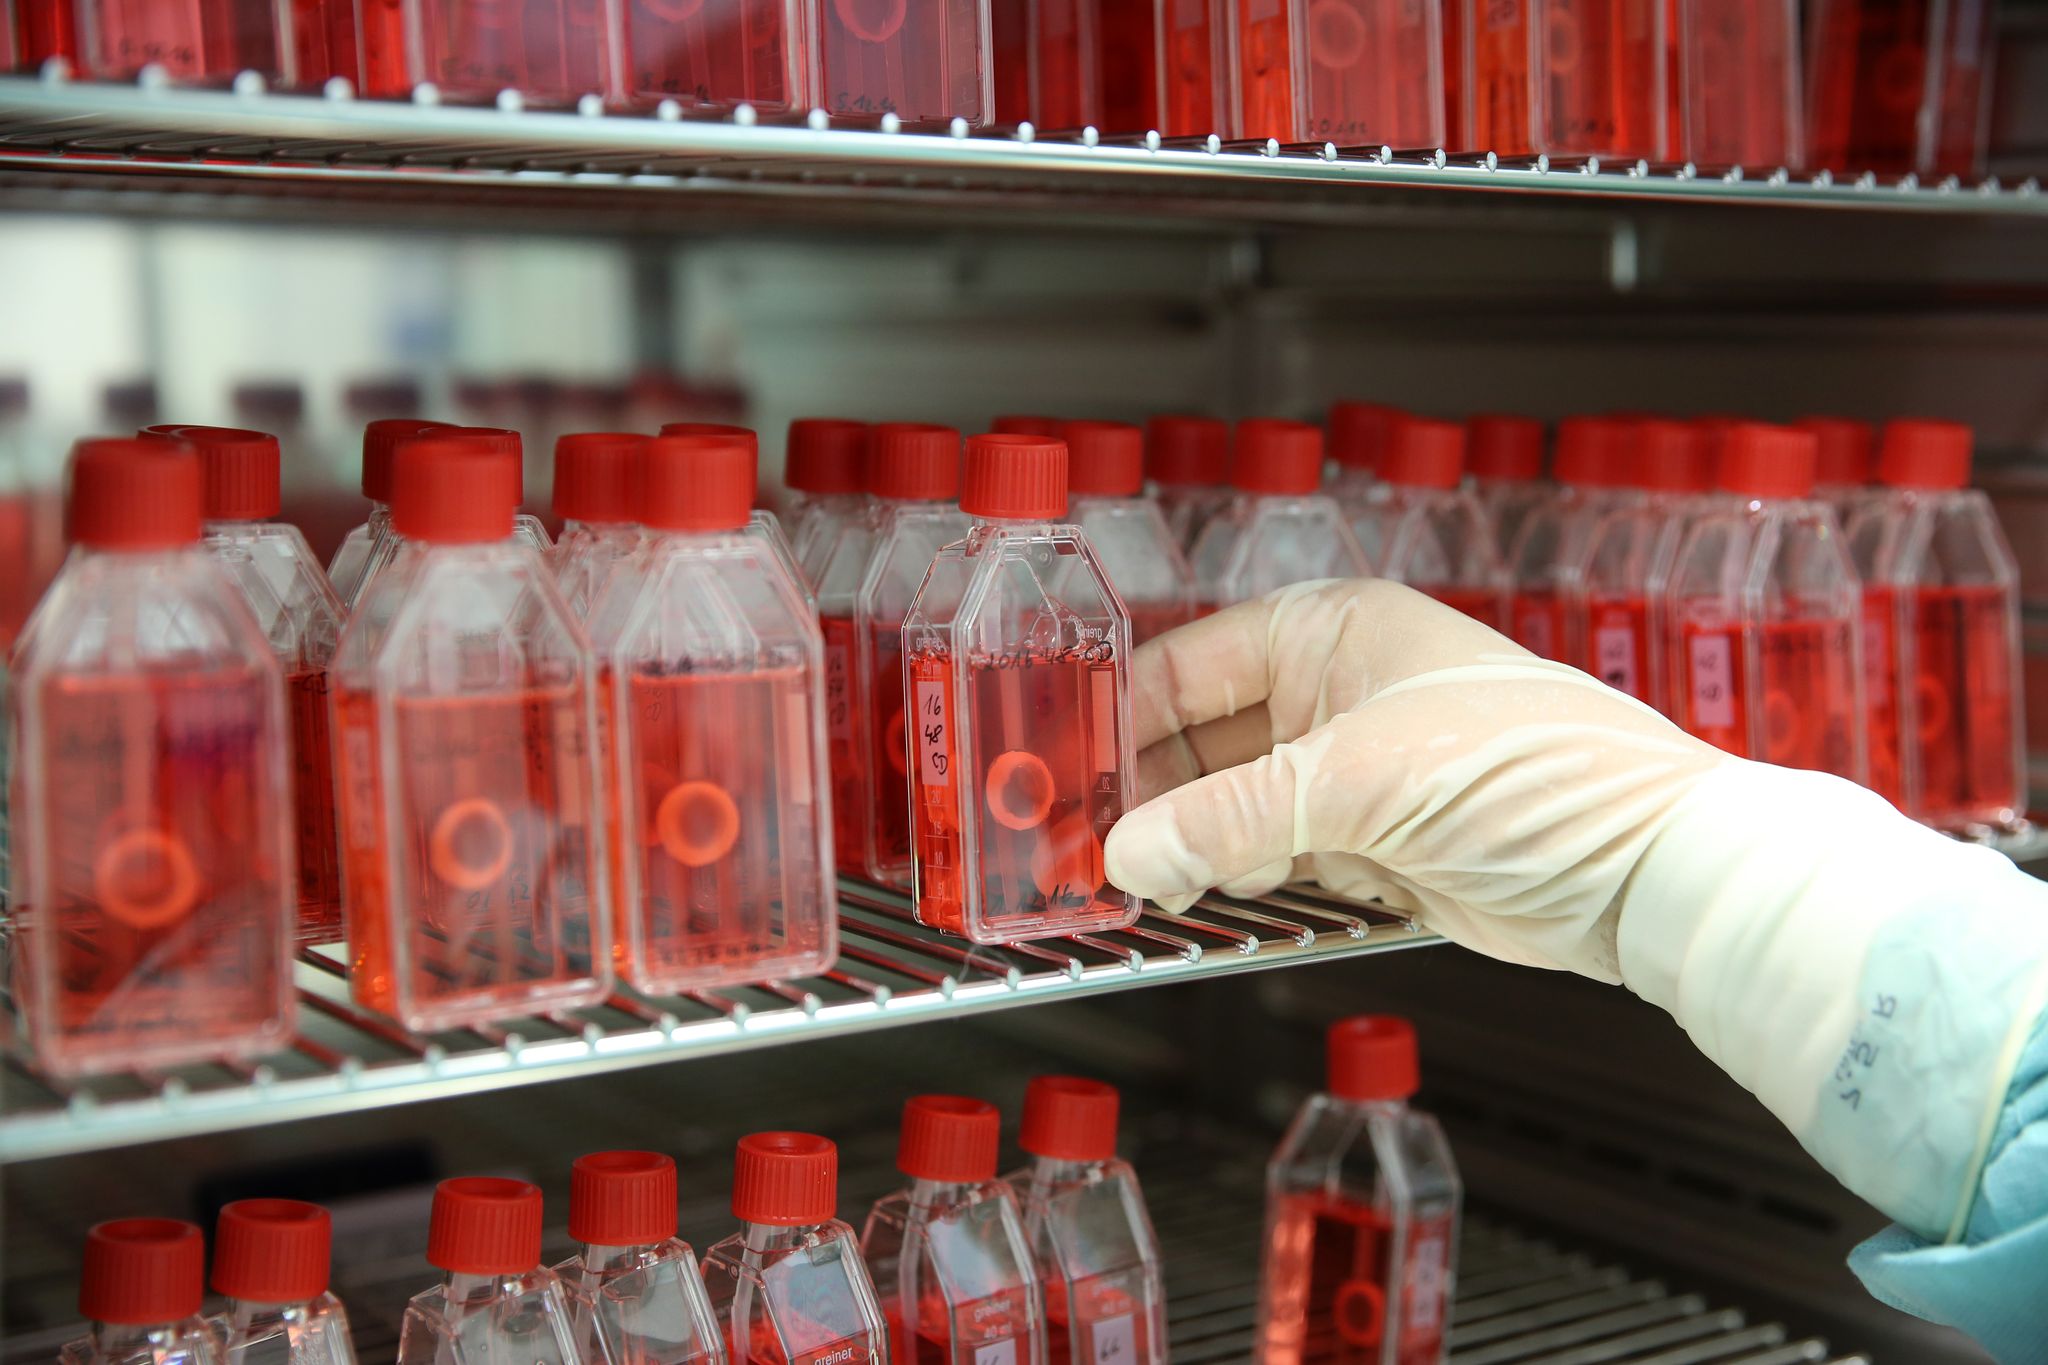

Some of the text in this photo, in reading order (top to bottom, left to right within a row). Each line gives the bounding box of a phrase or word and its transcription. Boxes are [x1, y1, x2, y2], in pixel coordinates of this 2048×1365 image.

[924, 693, 942, 716] 16
[924, 723, 943, 747] 48
[983, 1325, 998, 1339] 40
[814, 1346, 853, 1365] greiner
